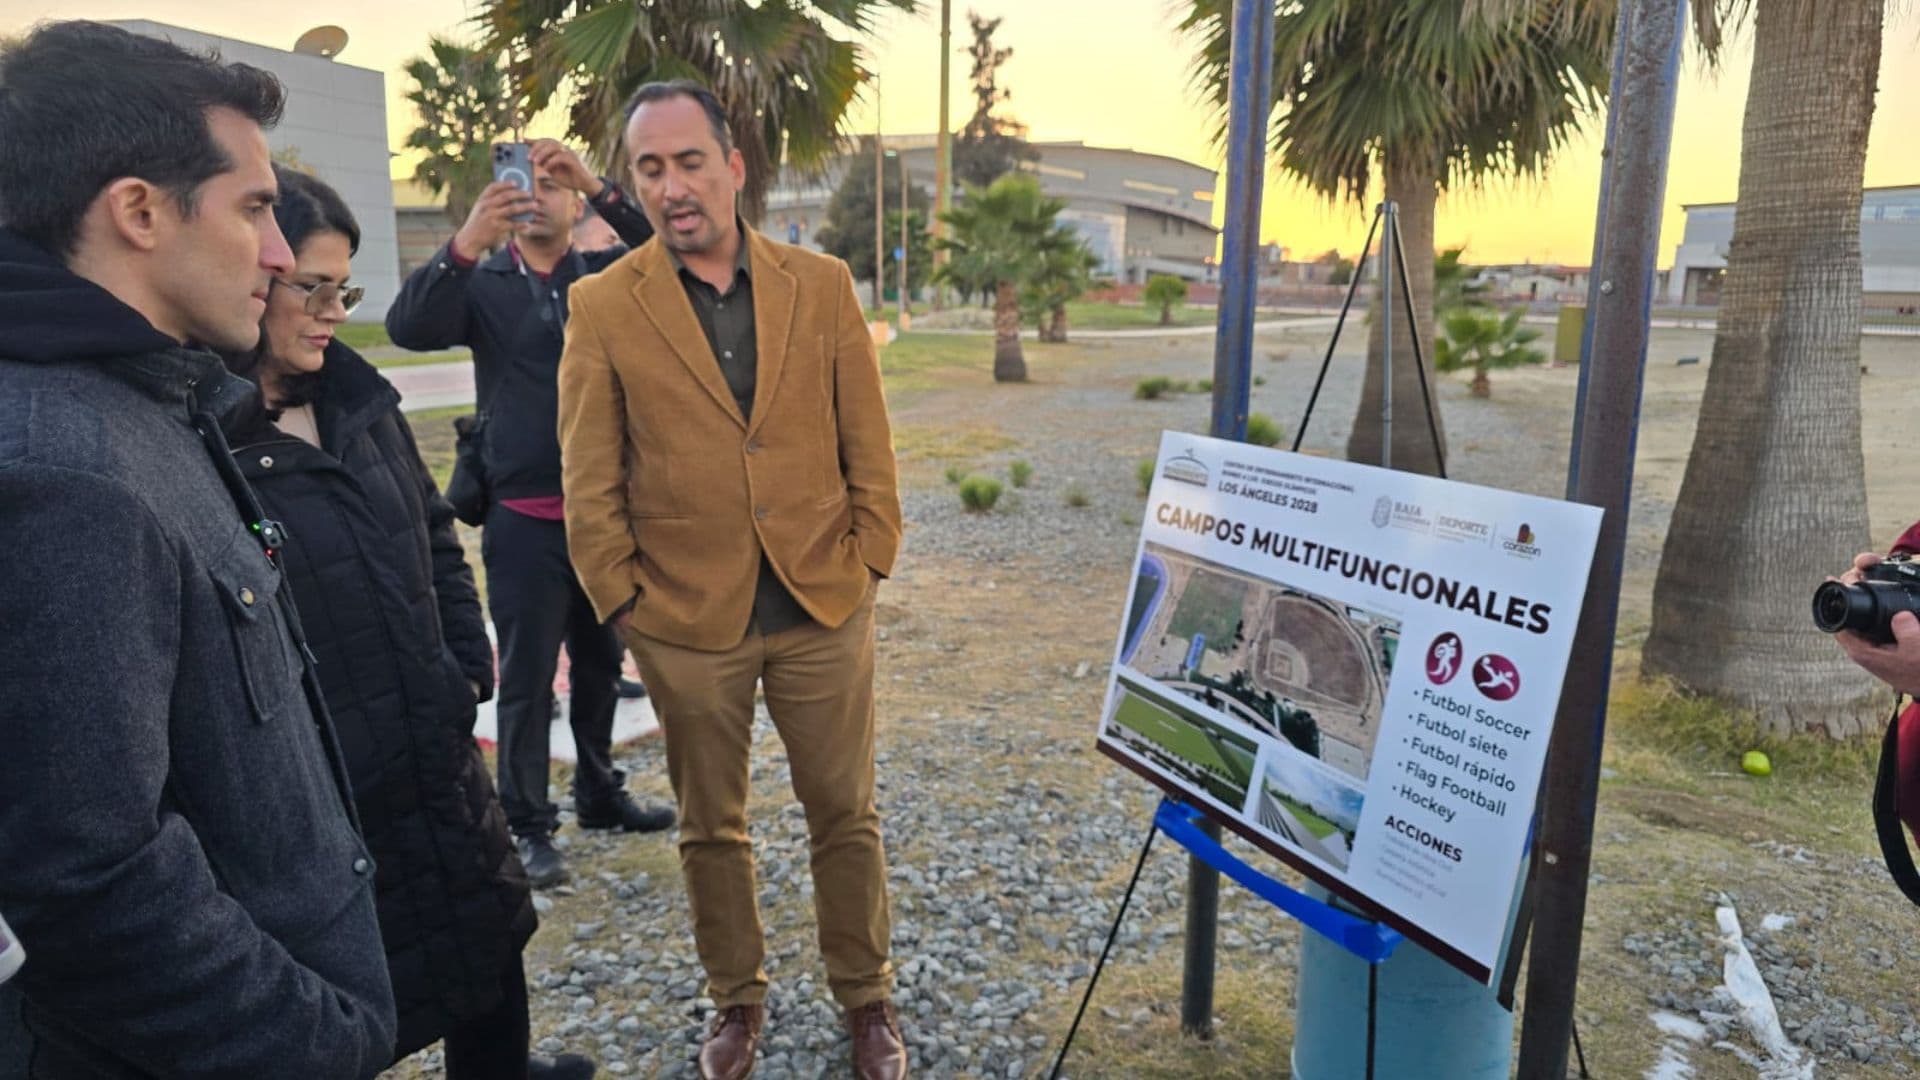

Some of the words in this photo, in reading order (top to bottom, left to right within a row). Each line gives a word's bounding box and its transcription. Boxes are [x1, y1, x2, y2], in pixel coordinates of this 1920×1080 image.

[1218, 480, 1238, 494] LOS
[1240, 484, 1289, 508] ÁNGELES
[1290, 496, 1319, 514] 2028
[1439, 515, 1489, 536] DEPORTE
[1156, 503, 1246, 546] CAMPOS
[1250, 527, 1552, 635] MULTIFUNCIONALES
[1416, 712, 1466, 743] Futbol
[1468, 735, 1508, 760] siete
[1422, 688, 1472, 719] Futbol
[1474, 709, 1531, 740] Soccer
[1405, 761, 1437, 788] Flag
[1441, 776, 1507, 816] Football
[1411, 737, 1460, 768] Futbol
[1463, 761, 1516, 792] rápido
[1400, 784, 1456, 823] Hockey
[1384, 815, 1463, 863] ACCIONES
